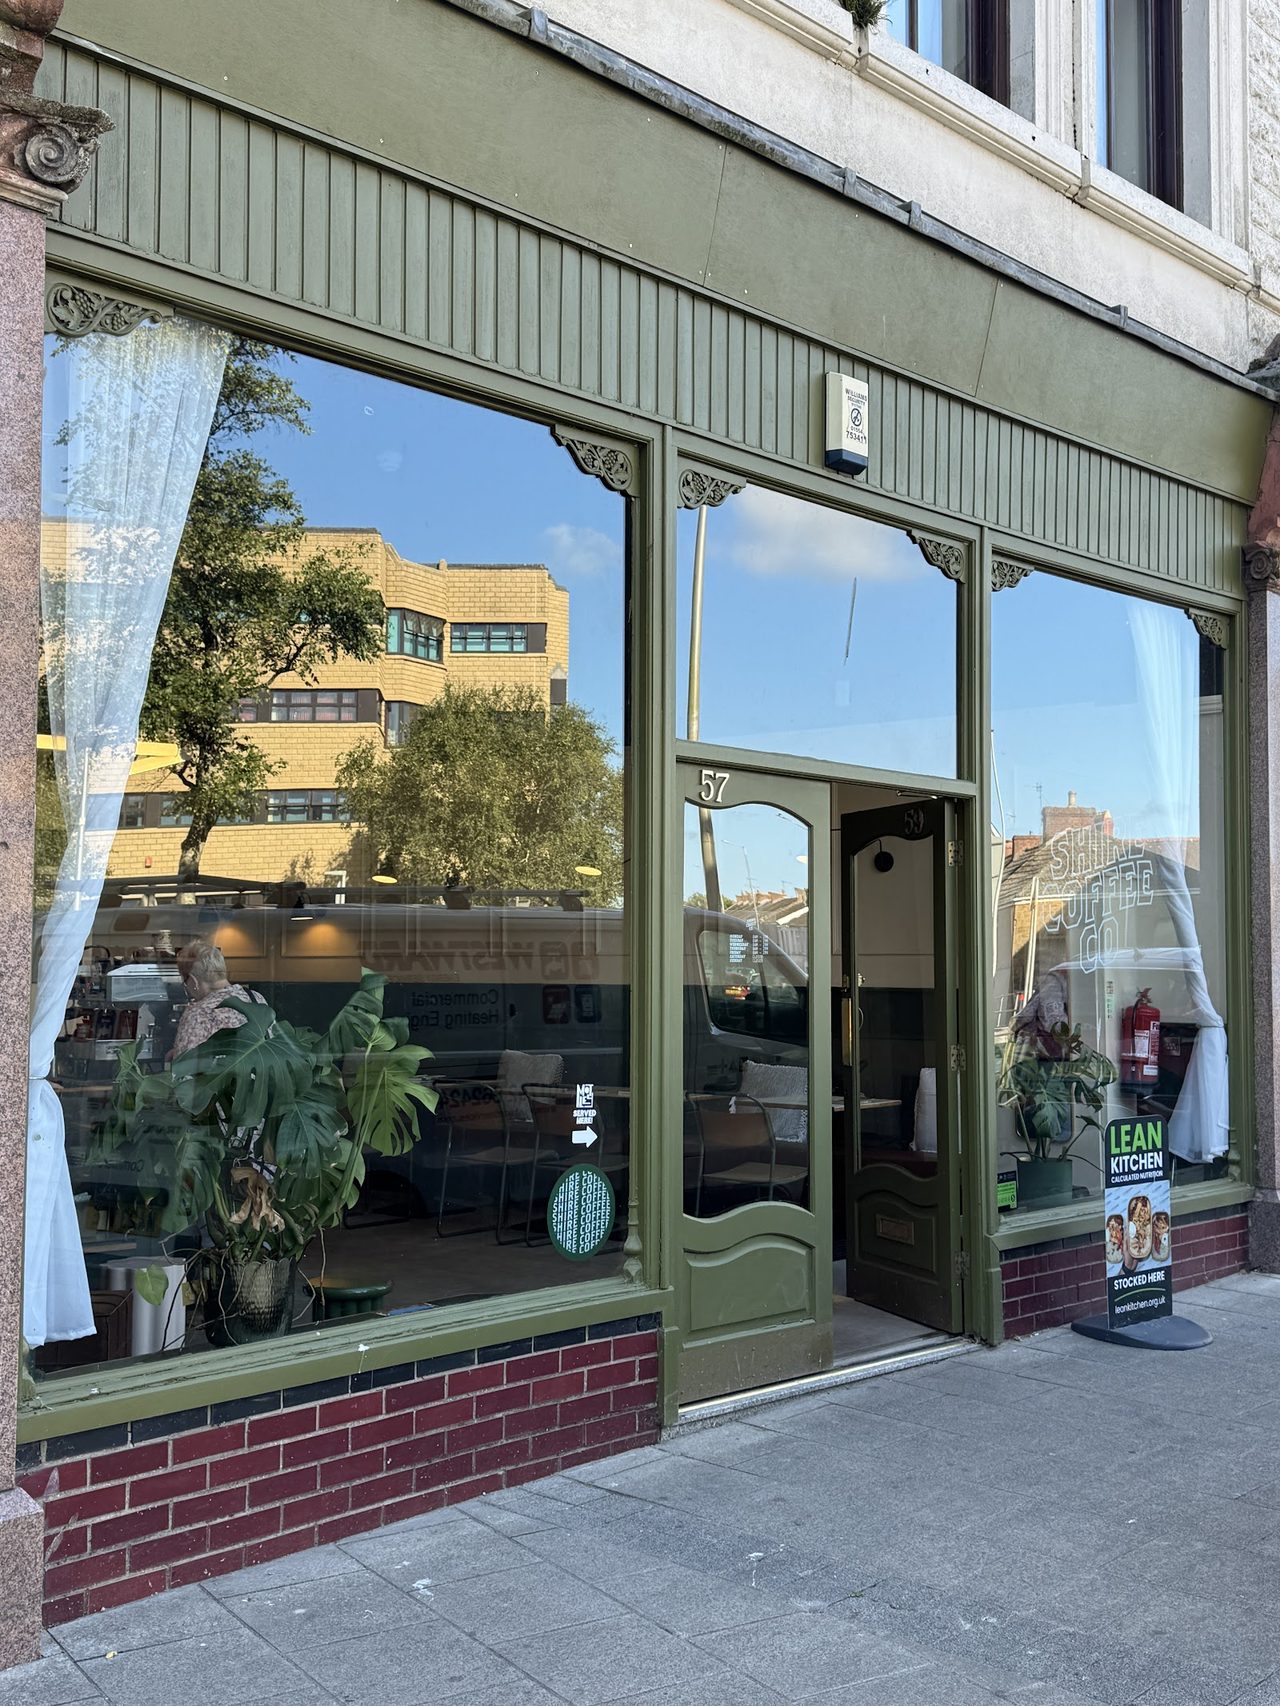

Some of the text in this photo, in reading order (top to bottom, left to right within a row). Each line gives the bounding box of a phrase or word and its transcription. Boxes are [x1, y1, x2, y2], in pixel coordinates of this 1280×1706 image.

[701, 769, 730, 802] 57
[1042, 860, 1154, 932] COFFEE
[1080, 917, 1119, 974] CO
[1110, 1121, 1162, 1154] LEAN
[1110, 1151, 1163, 1175] KITCHEN
[1111, 1173, 1139, 1183] CALCULATED
[1114, 1270, 1165, 1290] STOCKED HERE
[1115, 1295, 1166, 1314] leankitchen.org.uk
